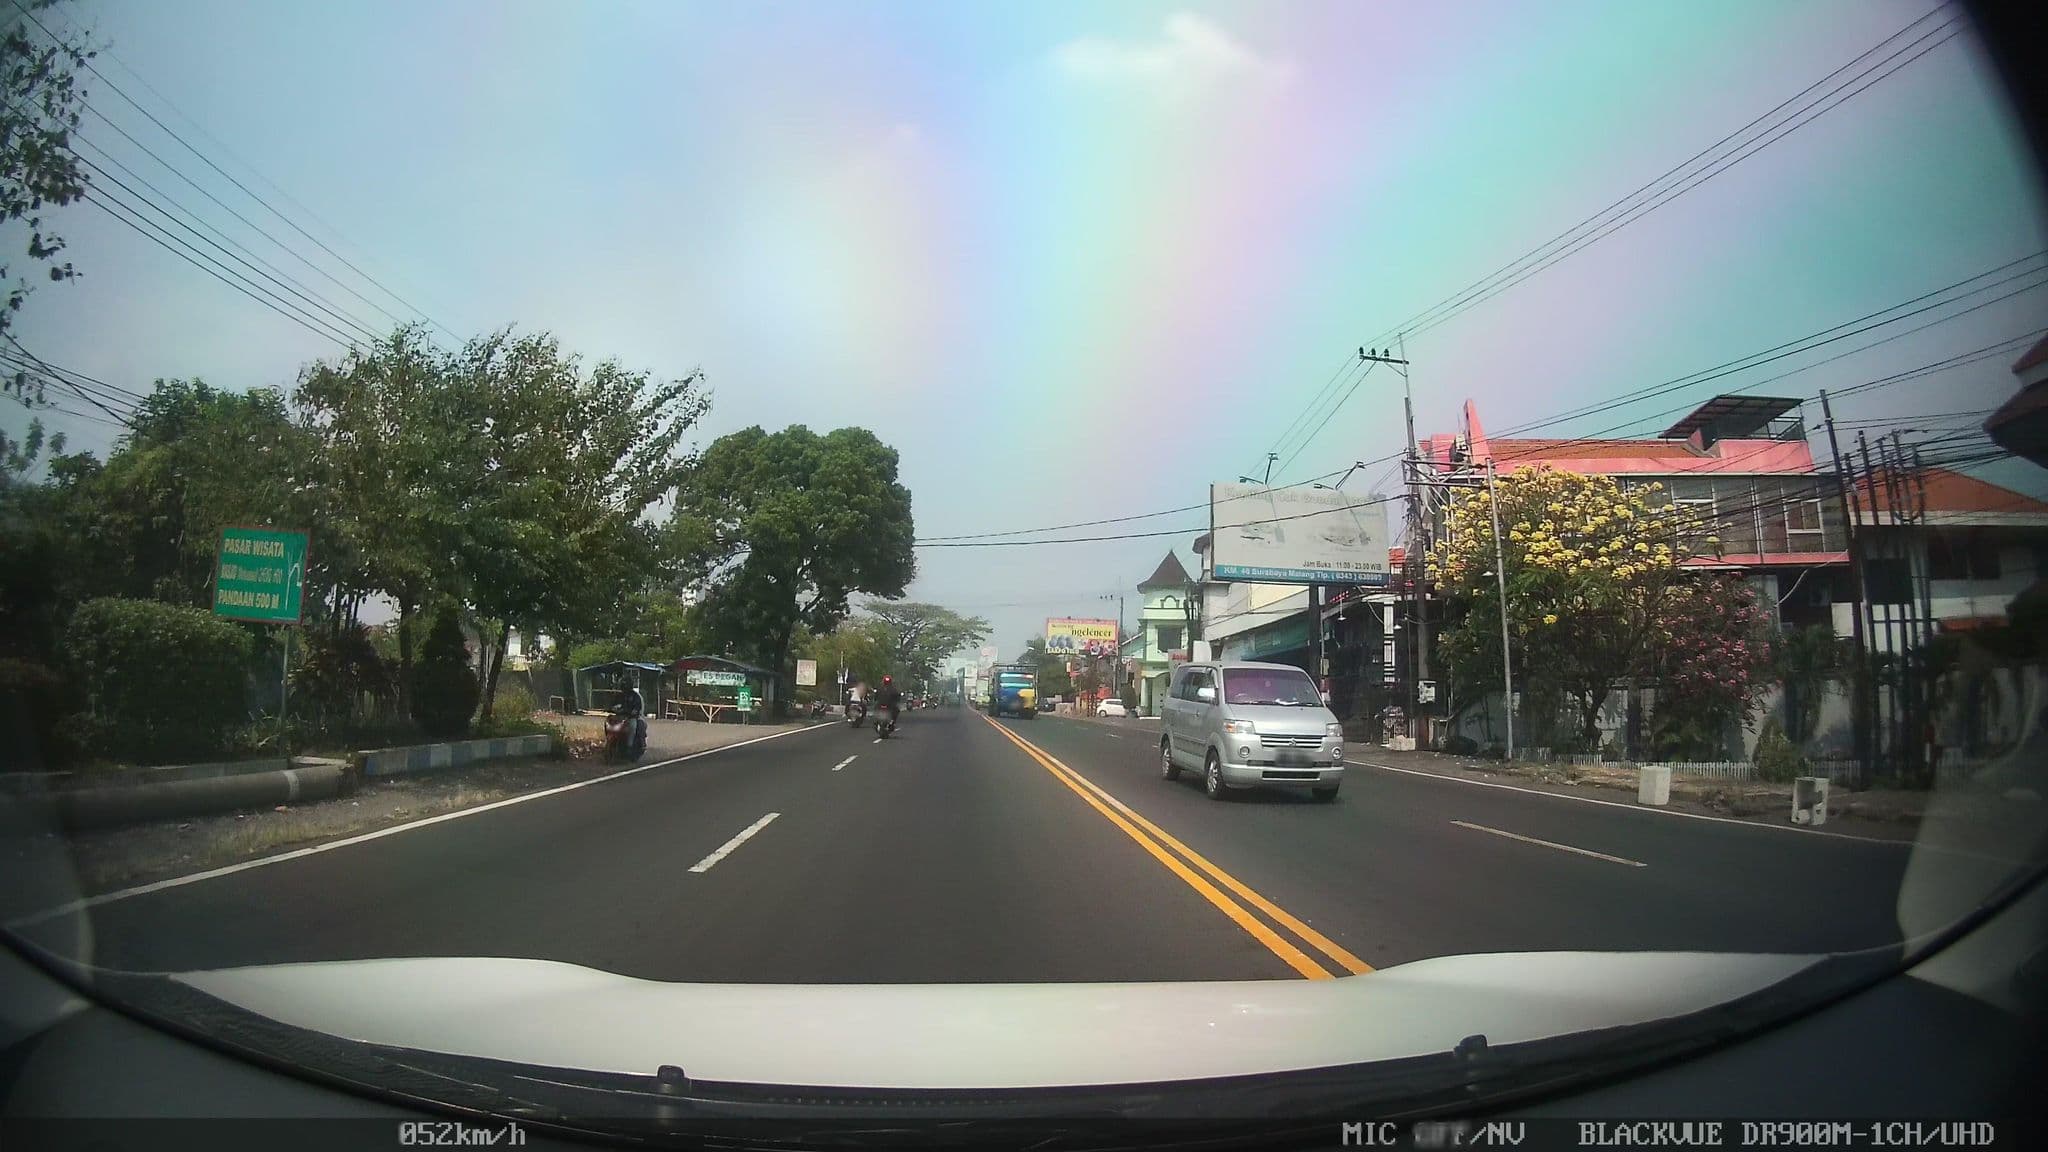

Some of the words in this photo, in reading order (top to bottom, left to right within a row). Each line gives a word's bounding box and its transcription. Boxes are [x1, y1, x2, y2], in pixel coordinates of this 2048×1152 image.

[225, 539, 251, 554] PASAR
[253, 541, 284, 557] WISATA
[1251, 568, 1288, 577] Surabaya
[1288, 570, 1314, 579] Malang
[218, 590, 254, 607] PANDAAN
[256, 593, 271, 608] 500
